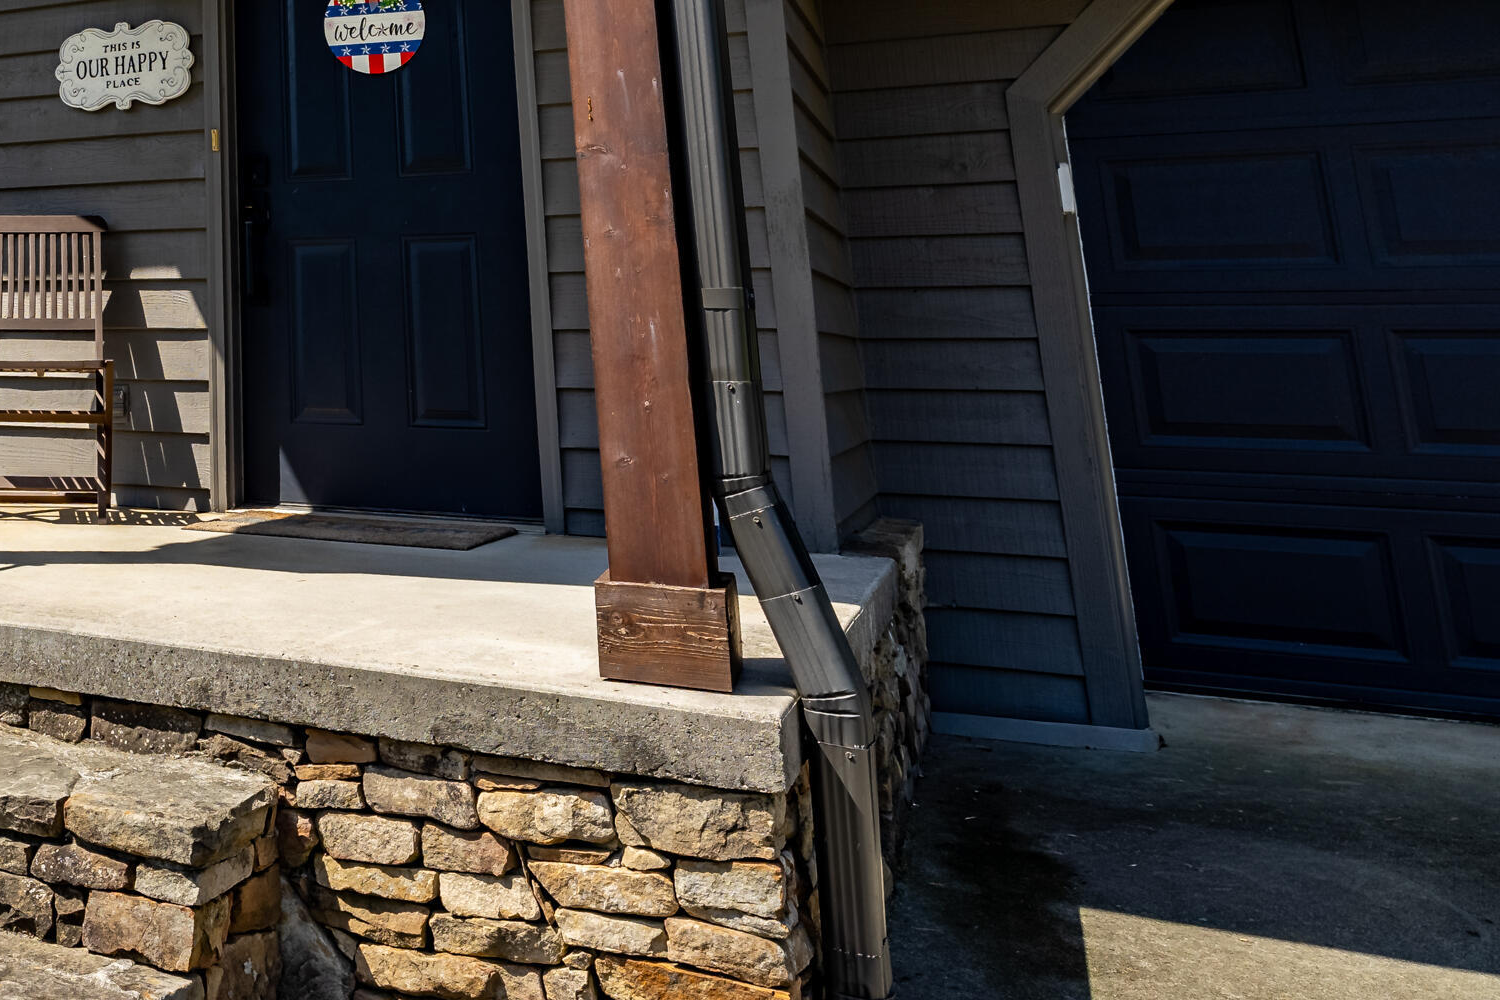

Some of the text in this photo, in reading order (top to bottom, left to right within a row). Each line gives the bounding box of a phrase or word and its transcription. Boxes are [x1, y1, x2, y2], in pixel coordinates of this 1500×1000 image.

[102, 41, 141, 53] THIS IS
[76, 51, 169, 80] OUR HAPPY
[106, 77, 141, 89] PLACE
